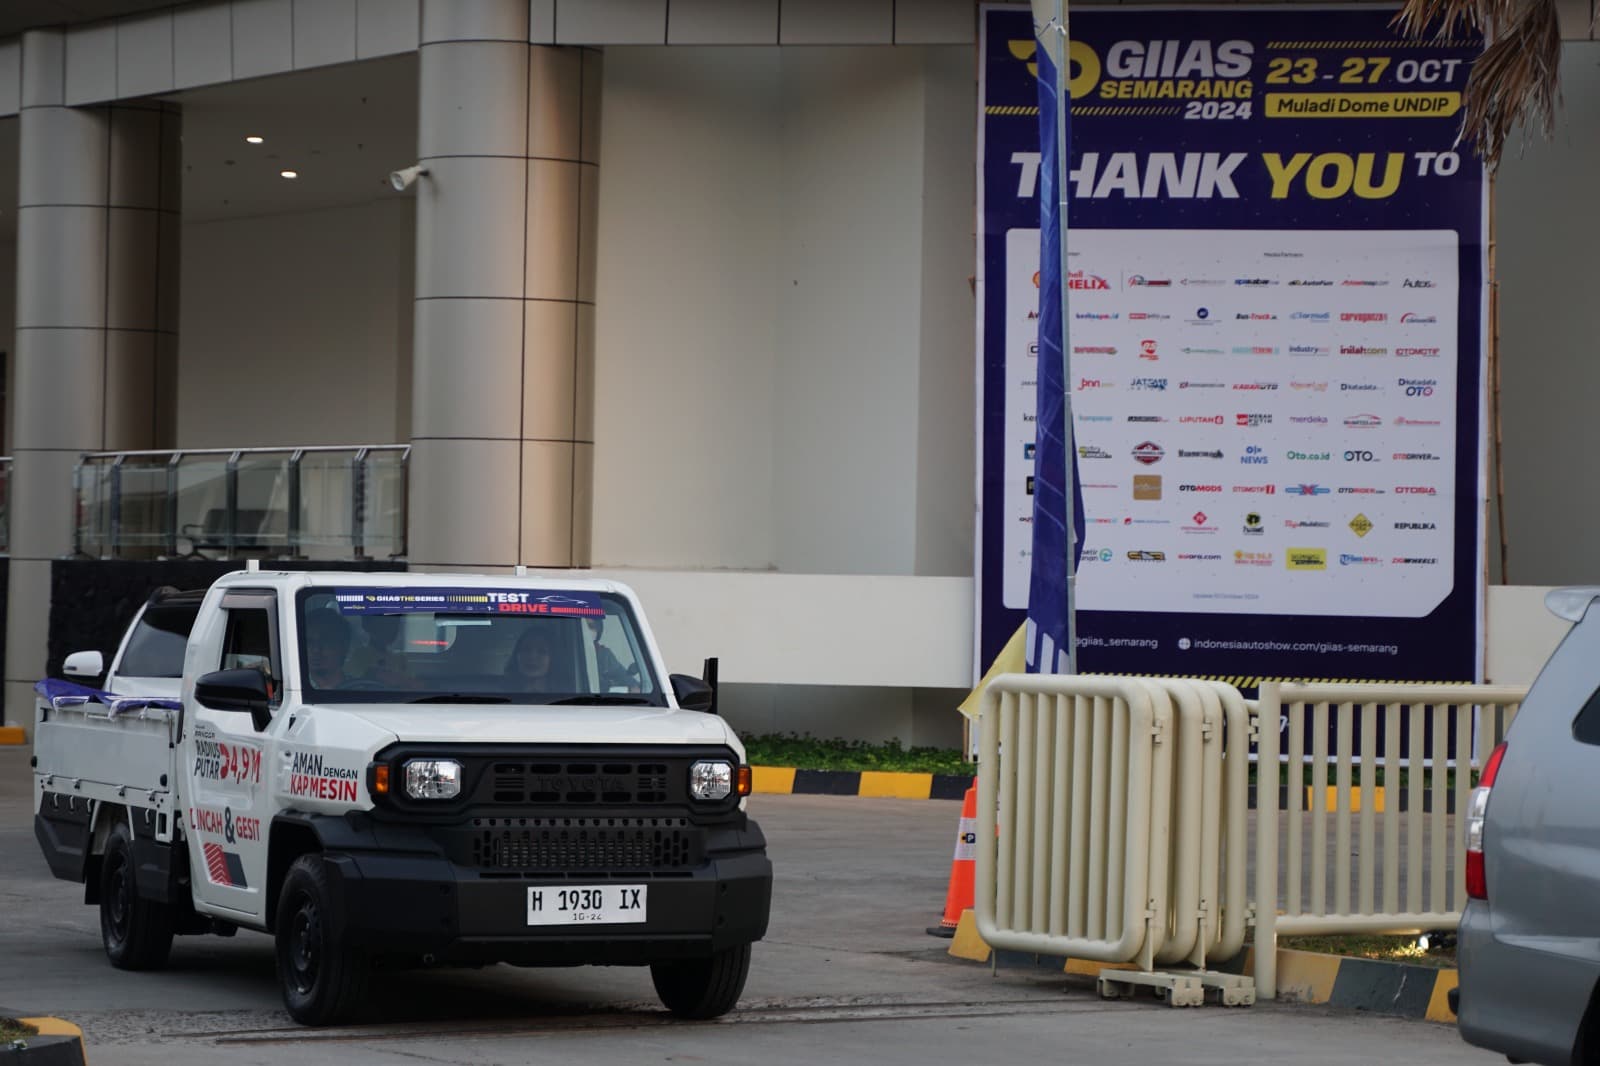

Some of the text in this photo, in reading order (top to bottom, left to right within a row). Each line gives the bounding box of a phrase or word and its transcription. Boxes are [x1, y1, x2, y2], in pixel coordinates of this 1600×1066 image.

[1106, 40, 1255, 78] GIIAS
[1265, 58, 1316, 84] 23
[1340, 57, 1392, 84] 27
[1396, 59, 1462, 84] OCT
[1100, 81, 1253, 99] SEMARANG
[1184, 101, 1253, 120] 2024
[1277, 97, 1449, 113] Muladi Dome UNDIP
[1263, 152, 1405, 199] YOU
[1414, 151, 1461, 177] TO
[1394, 522, 1437, 531] REPUBLIKA
[487, 592, 530, 603] TEST
[498, 603, 548, 613] DRIVE
[1194, 636, 1399, 656] indonesiaautoshow.com/giias-semarang
[193, 757, 220, 780] PUTAR
[292, 751, 358, 780] AMAN DENGAN
[290, 774, 358, 802] KAP MESIN
[235, 815, 260, 841] GESIT
[532, 888, 641, 912] H 1930 IX
[573, 912, 603, 921] 10-24
